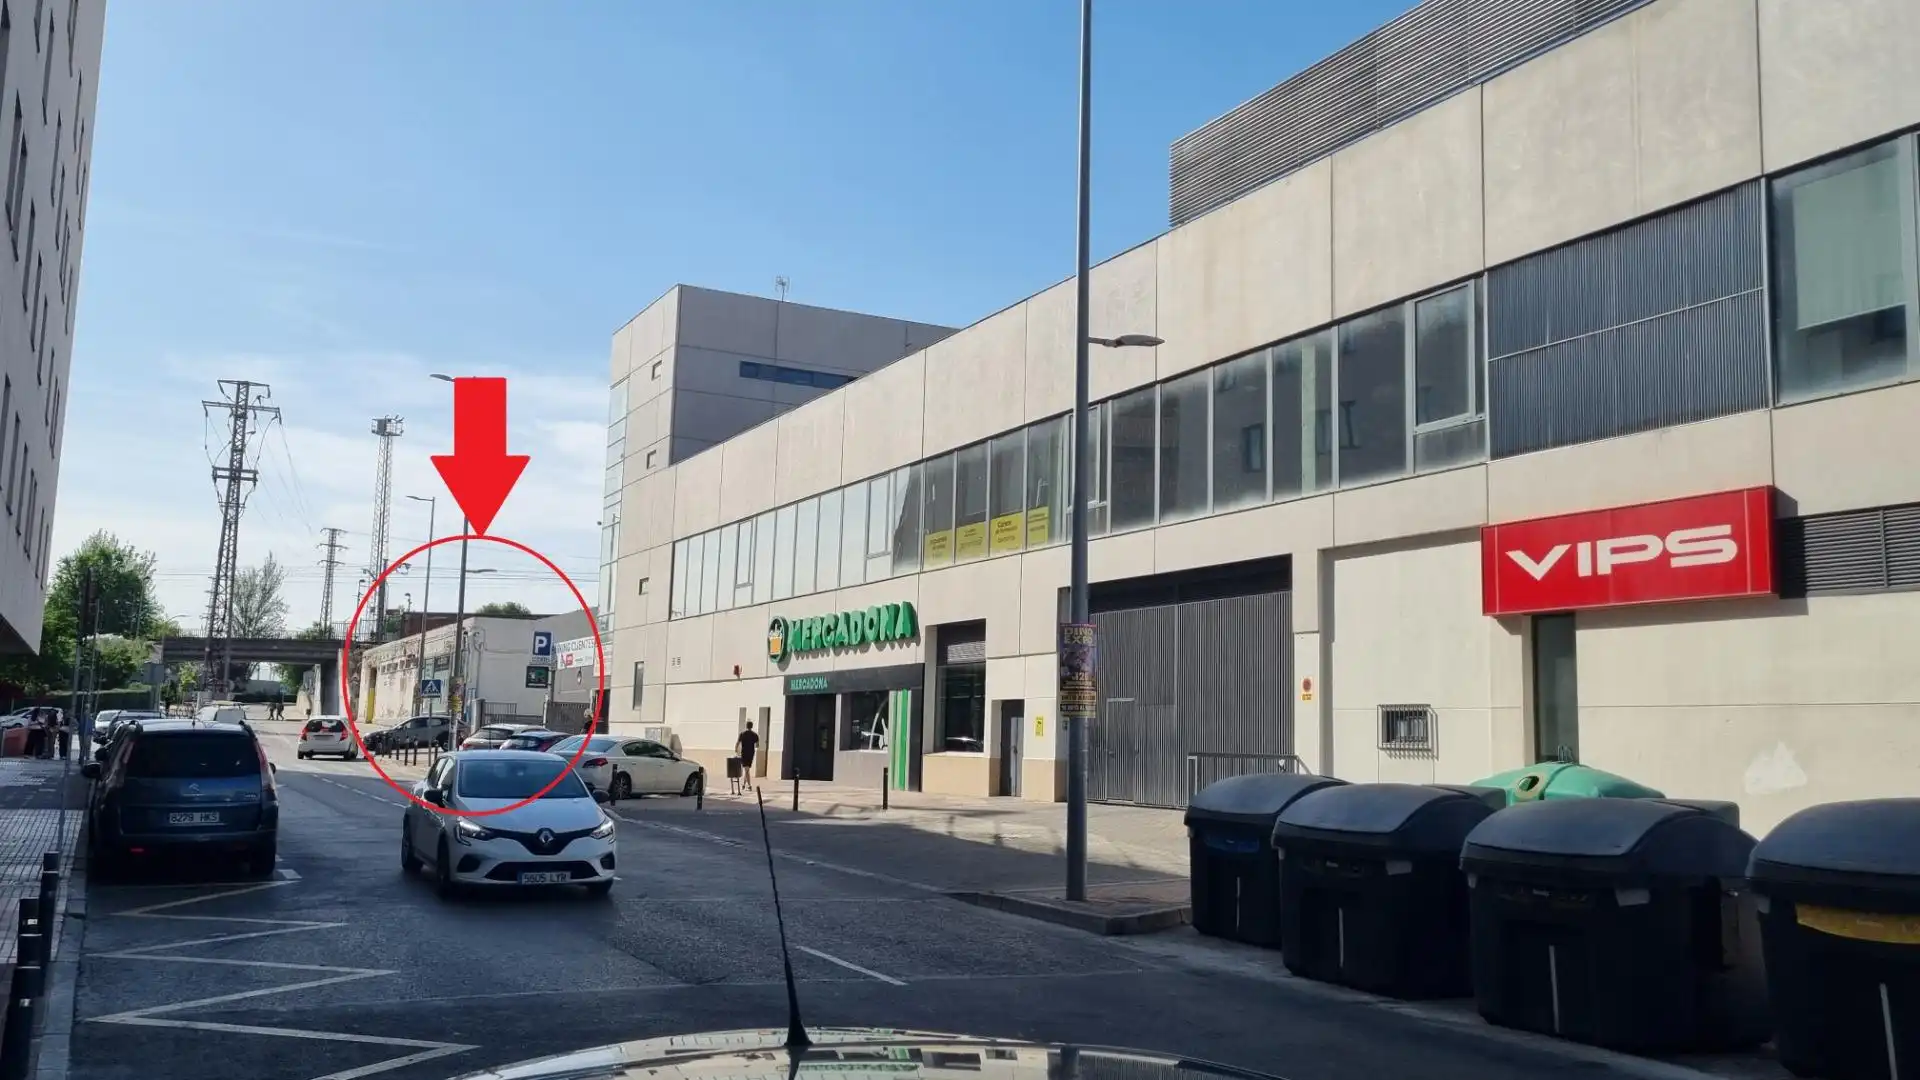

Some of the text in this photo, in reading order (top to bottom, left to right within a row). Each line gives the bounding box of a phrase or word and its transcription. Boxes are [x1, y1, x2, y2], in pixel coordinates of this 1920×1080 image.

[1505, 525, 1738, 581] VIPS
[787, 601, 915, 652] MERCADONA
[535, 635, 548, 654] P
[790, 676, 828, 691] MERCADONA
